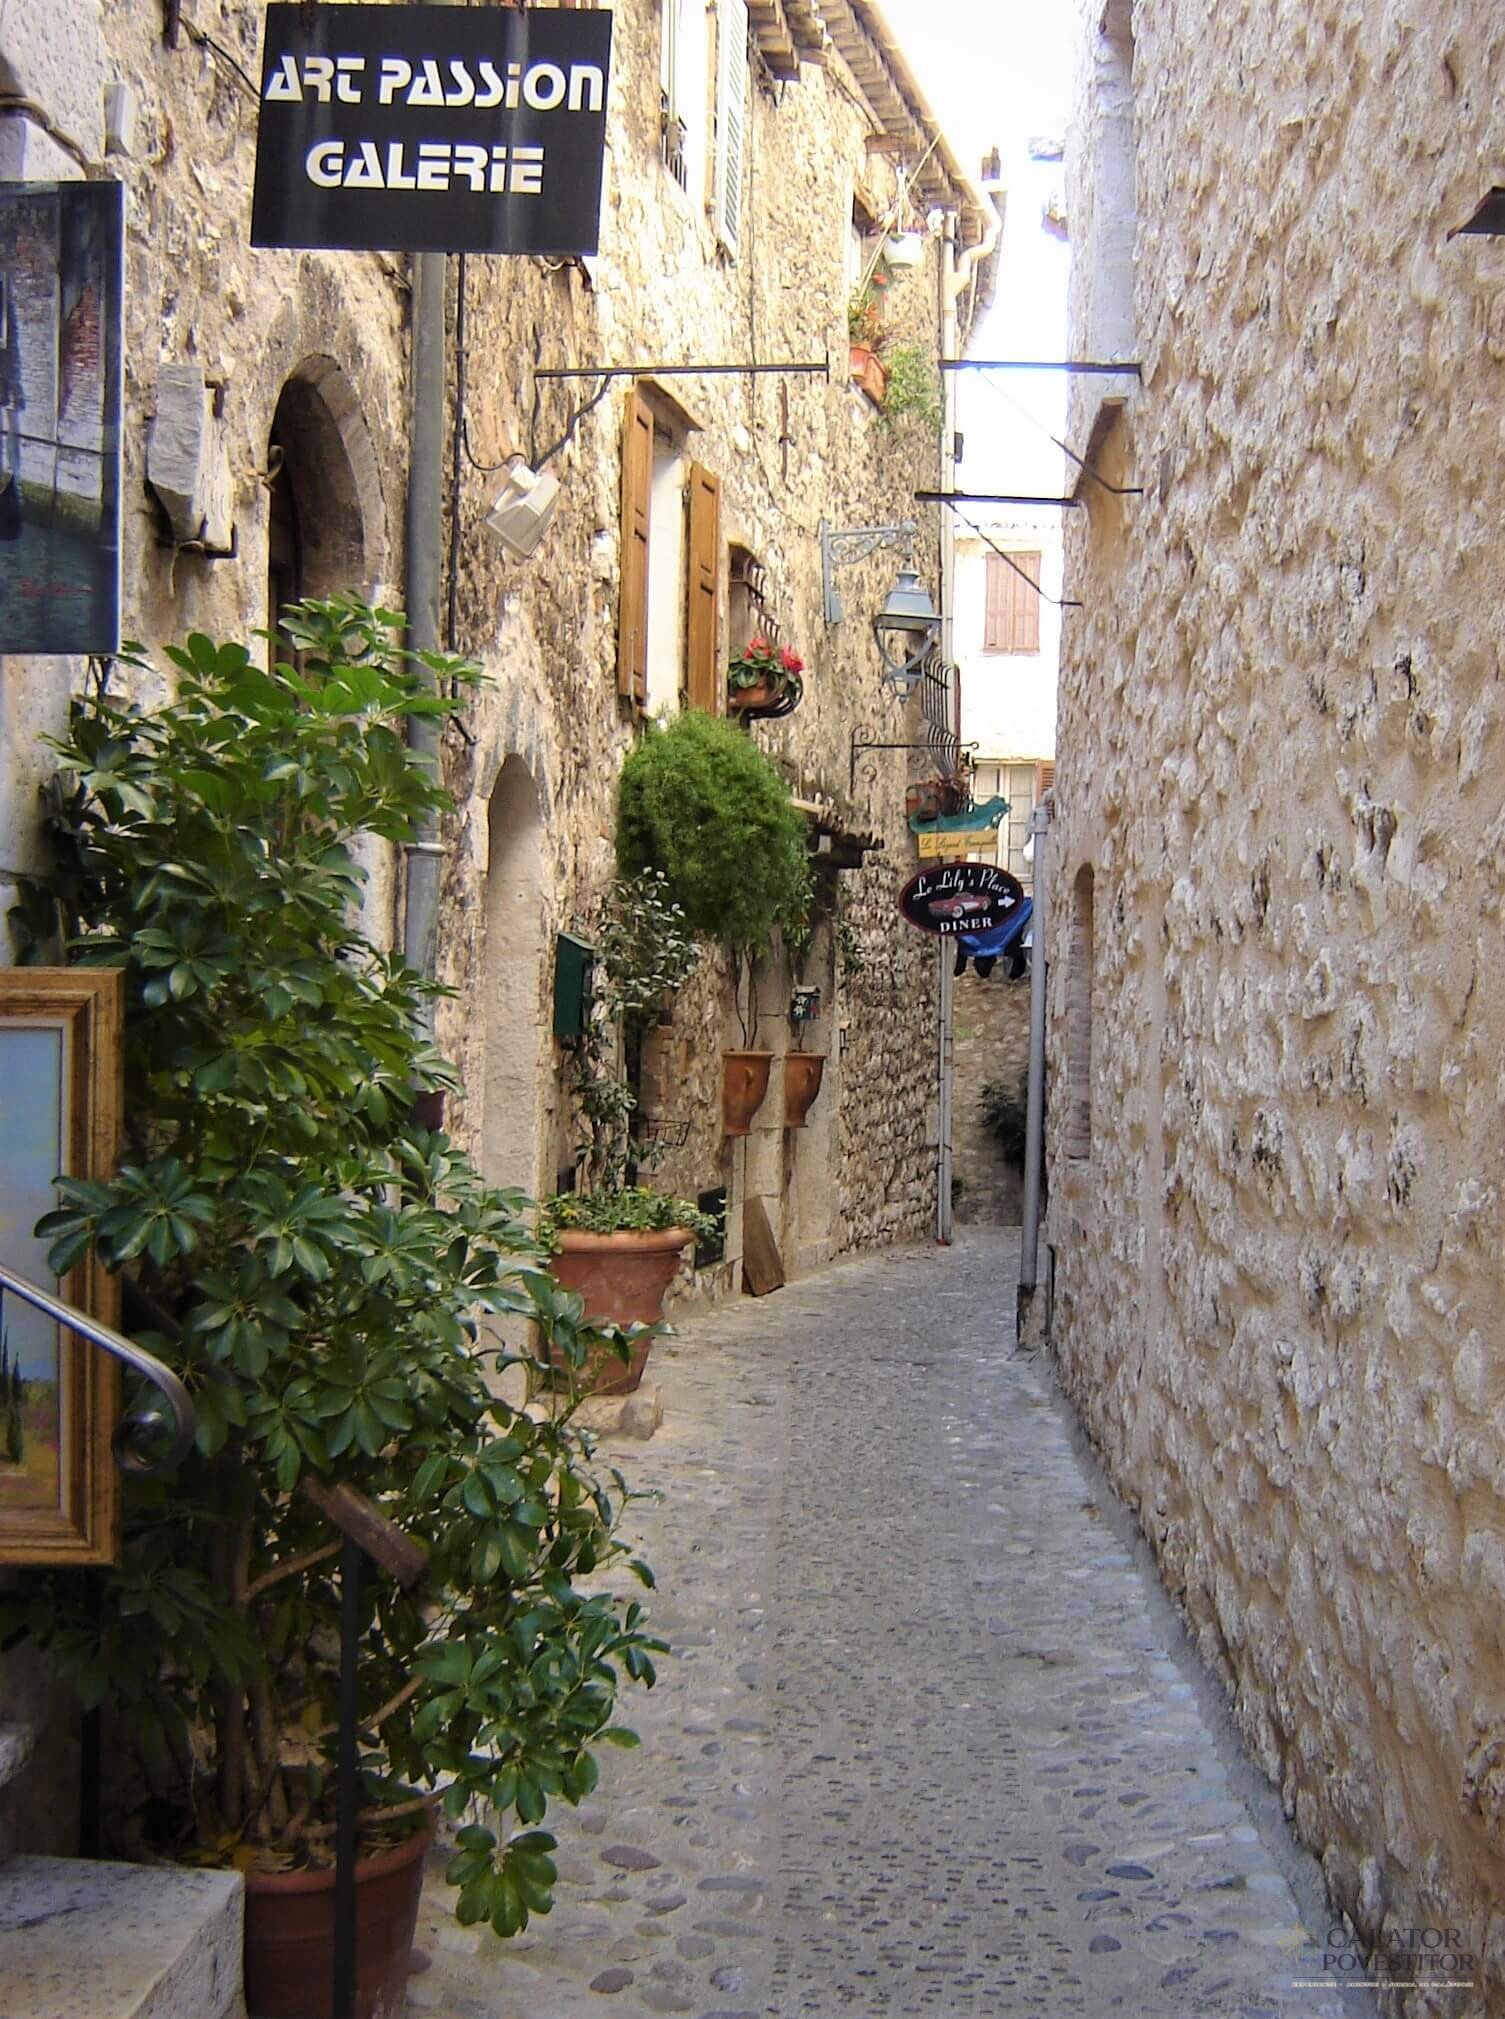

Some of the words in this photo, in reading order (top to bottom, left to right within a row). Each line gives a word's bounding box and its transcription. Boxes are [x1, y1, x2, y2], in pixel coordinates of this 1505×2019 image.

[264, 55, 366, 104] ART
[305, 141, 545, 194] GALERIE
[936, 868, 974, 891] Lily's
[979, 867, 1011, 894] Place
[940, 916, 993, 932] DINER
